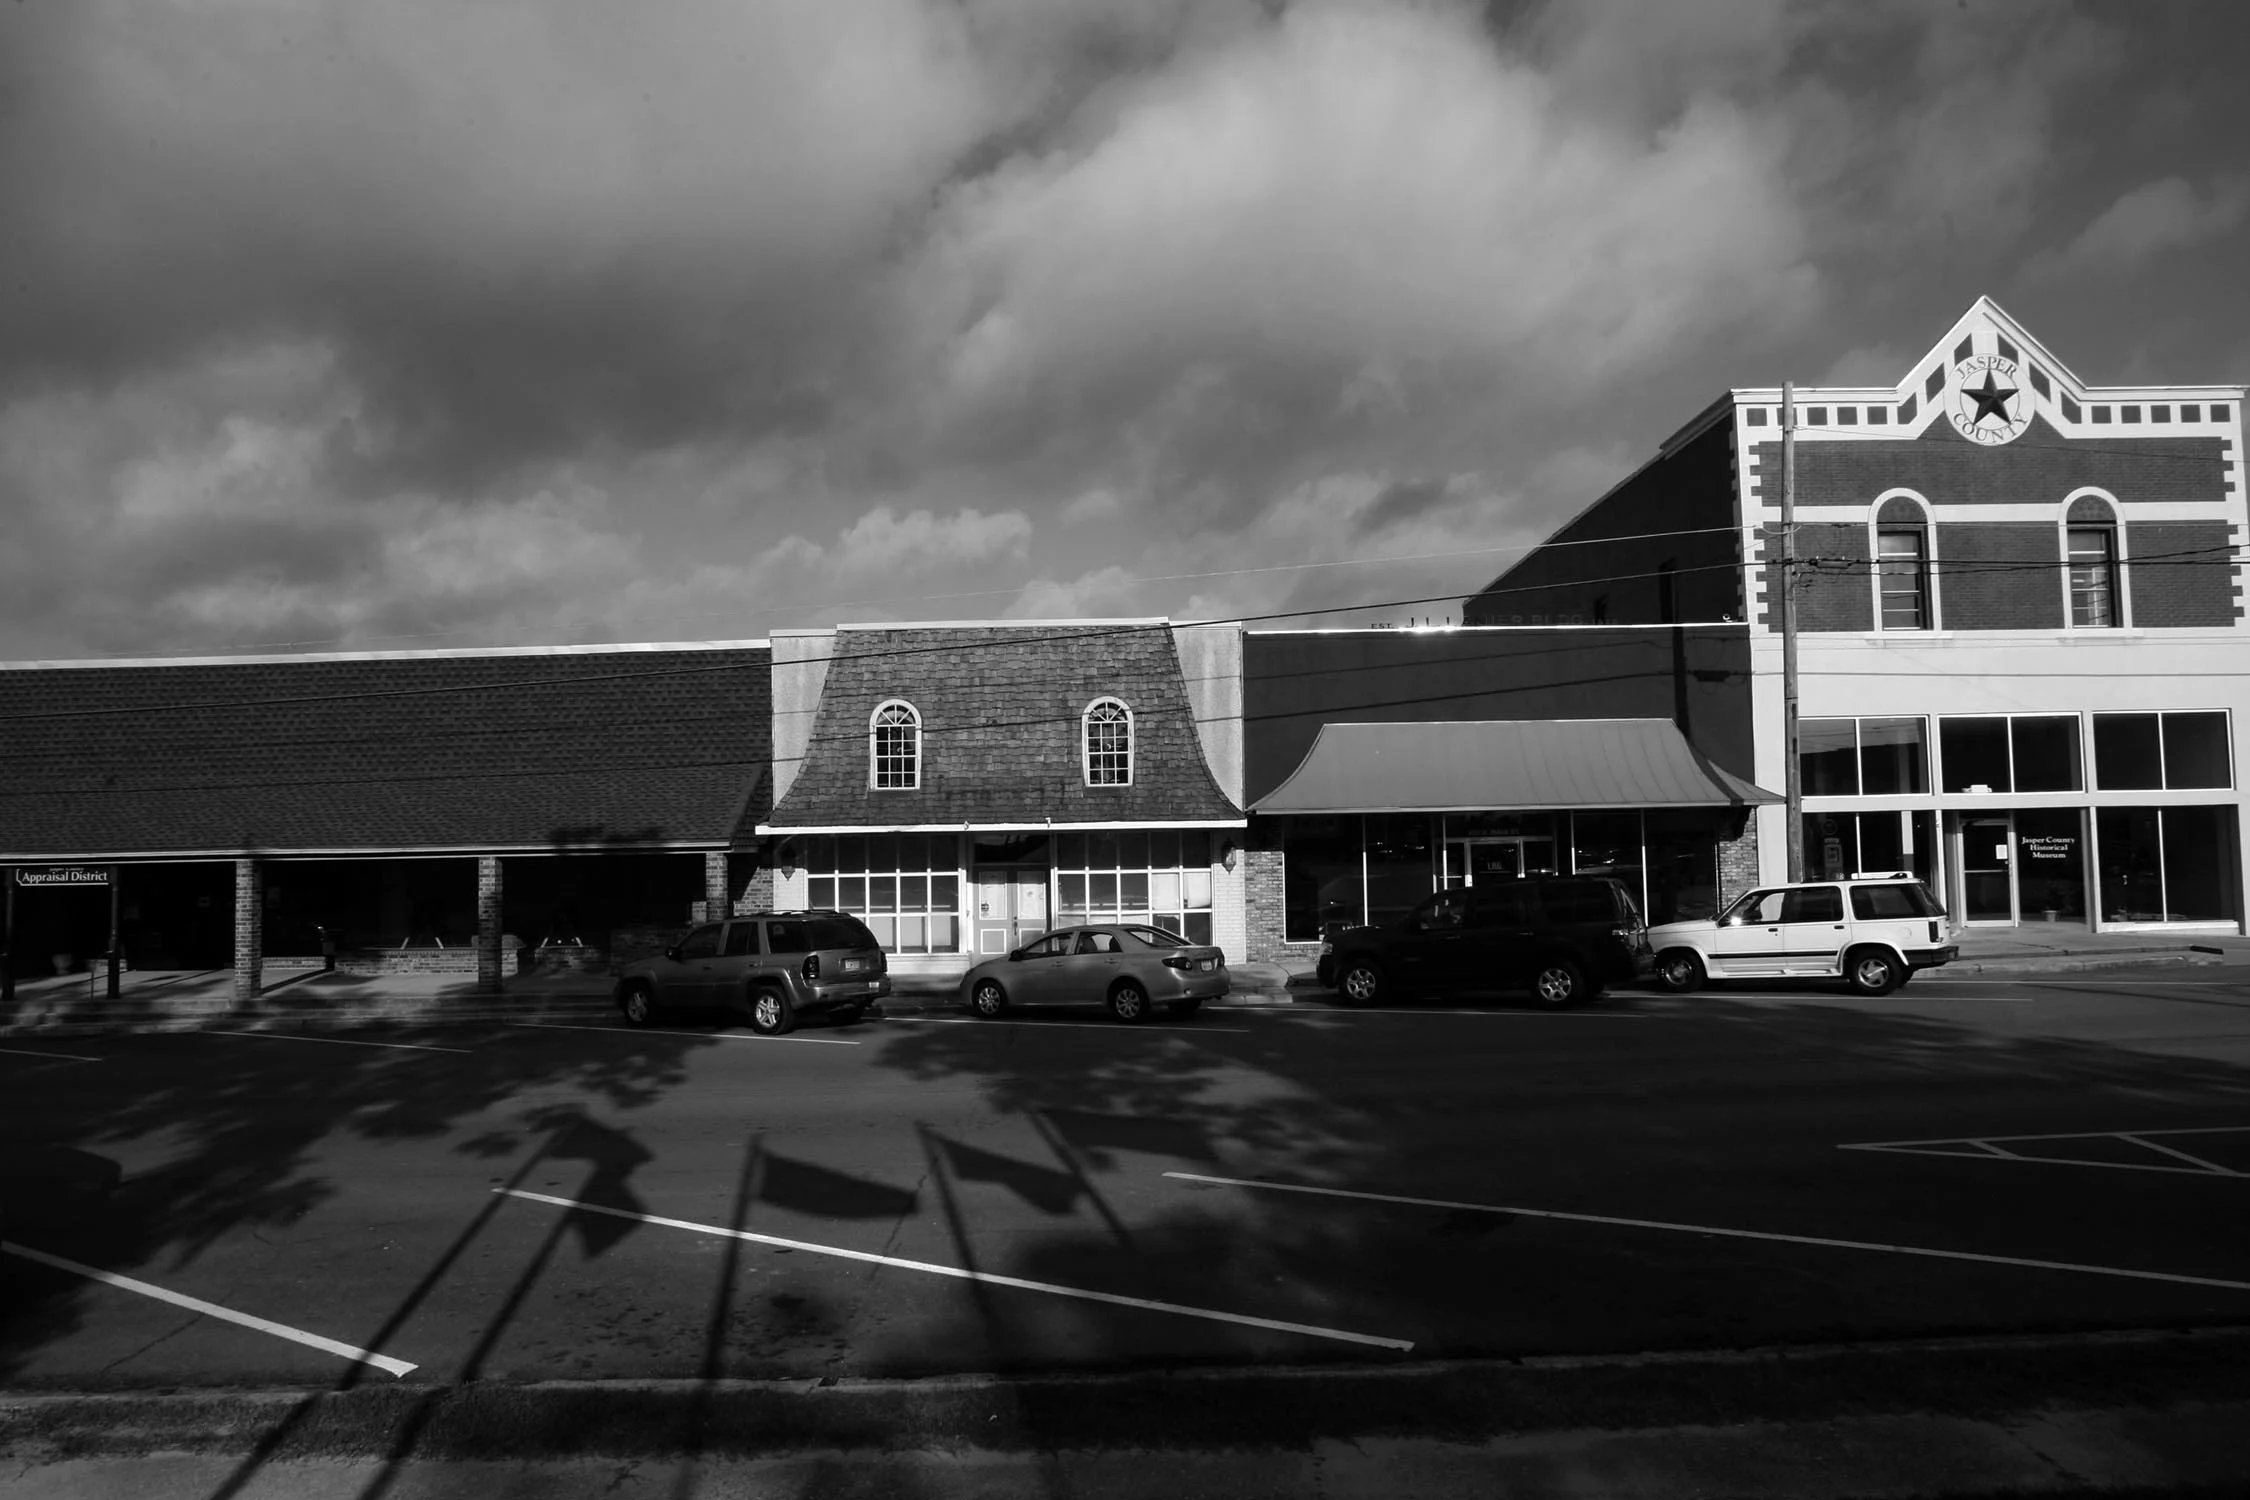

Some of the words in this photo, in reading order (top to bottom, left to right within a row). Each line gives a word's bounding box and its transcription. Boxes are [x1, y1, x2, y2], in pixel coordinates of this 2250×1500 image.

[1955, 356, 2017, 379] JASPER
[1953, 413, 2028, 443] COUNTY
[2021, 836, 2045, 845] Jasper
[2046, 836, 2075, 844] County
[22, 872, 69, 883] Appraisal
[71, 871, 108, 881] District
